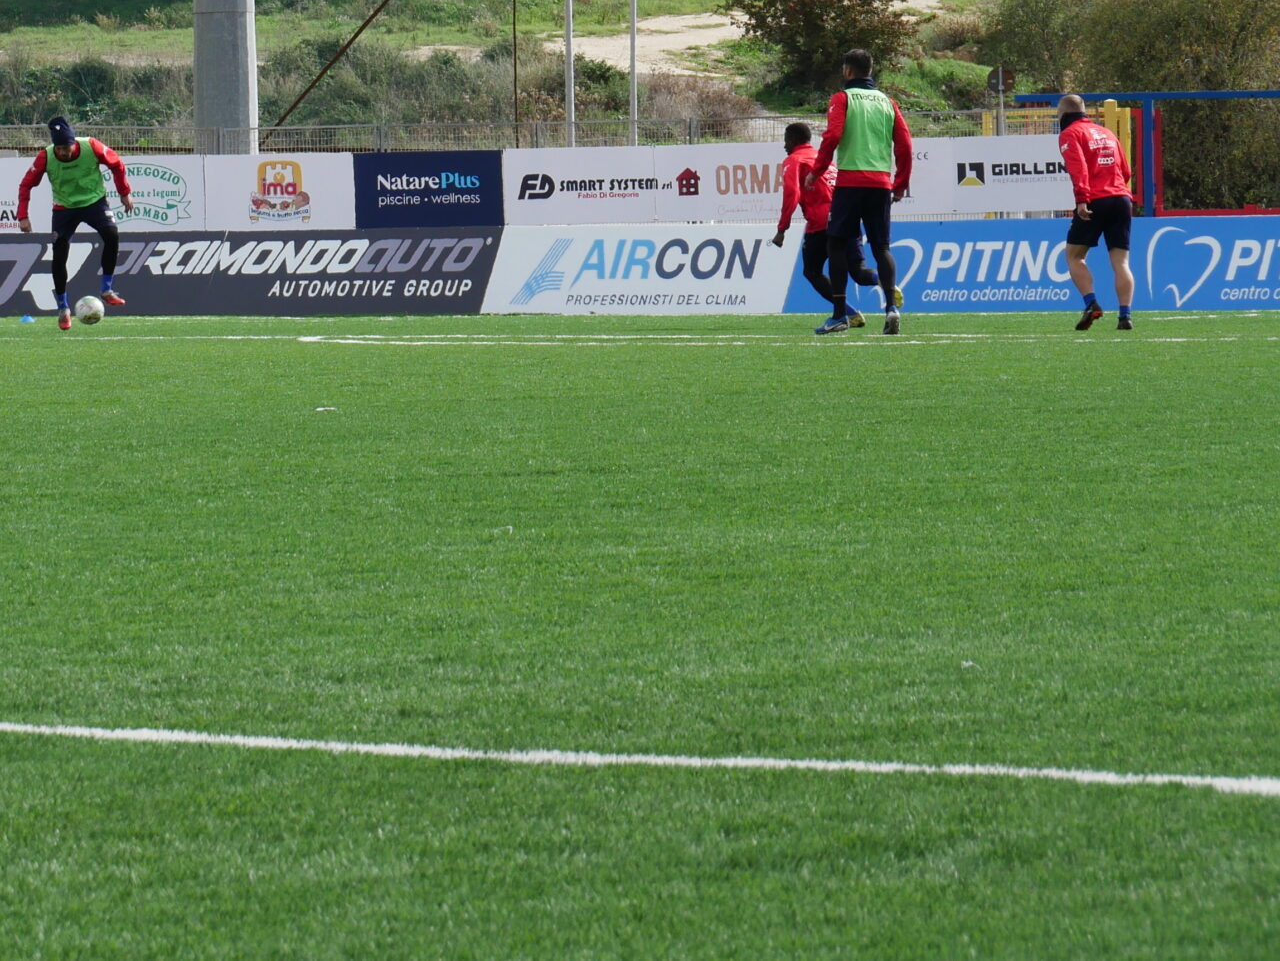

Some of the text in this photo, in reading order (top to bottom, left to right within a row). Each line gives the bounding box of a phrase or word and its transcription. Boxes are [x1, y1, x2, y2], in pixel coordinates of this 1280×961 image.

[126, 166, 180, 186] NEGOZIO
[262, 177, 297, 196] ima
[559, 179, 605, 192] SMART
[609, 177, 658, 191] SYSTEM
[152, 189, 181, 199] legumi
[378, 192, 481, 208] piscine wellness
[609, 191, 639, 199] Gregorio
[114, 207, 169, 222] OLOMBO
[569, 238, 763, 289] AIRCON
[1225, 239, 1280, 281] PI
[268, 278, 473, 297] AUTOMOTIVE GROUP
[921, 285, 1070, 302] centro odontoiatrico
[1220, 285, 1270, 301] centro
[565, 294, 747, 306] PROFESSIONISTI DEL CLIMA
